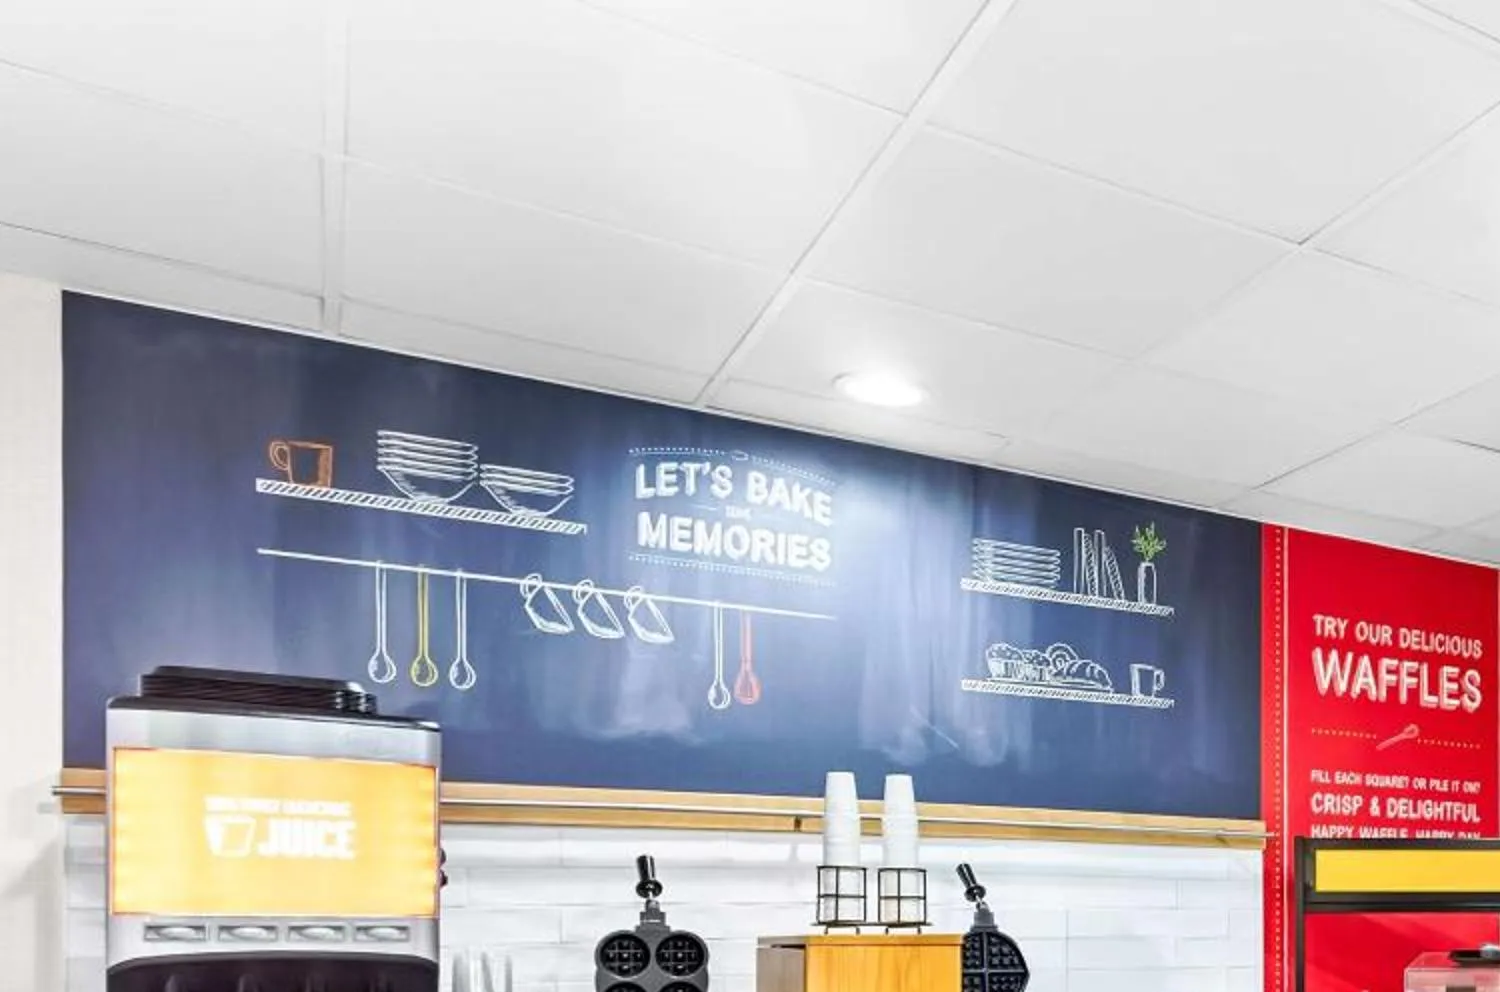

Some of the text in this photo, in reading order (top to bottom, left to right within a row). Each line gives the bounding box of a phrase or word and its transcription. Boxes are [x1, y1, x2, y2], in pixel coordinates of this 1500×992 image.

[635, 461, 833, 527] LET'S BAKE
[637, 511, 832, 572] MEMORIES
[1312, 613, 1483, 661] TRY OUR DELICIOUS
[1312, 647, 1482, 713] WAFFLES
[1311, 769, 1331, 783] FILL
[1335, 771, 1361, 786] EACH
[1412, 777, 1427, 790] OR
[1429, 778, 1448, 792] PILE
[1451, 780, 1460, 794] IT
[1311, 791, 1481, 823] CRISP & DELIGHTFUL
[257, 816, 356, 860] JUICE
[1311, 824, 1354, 839] HAPPY
